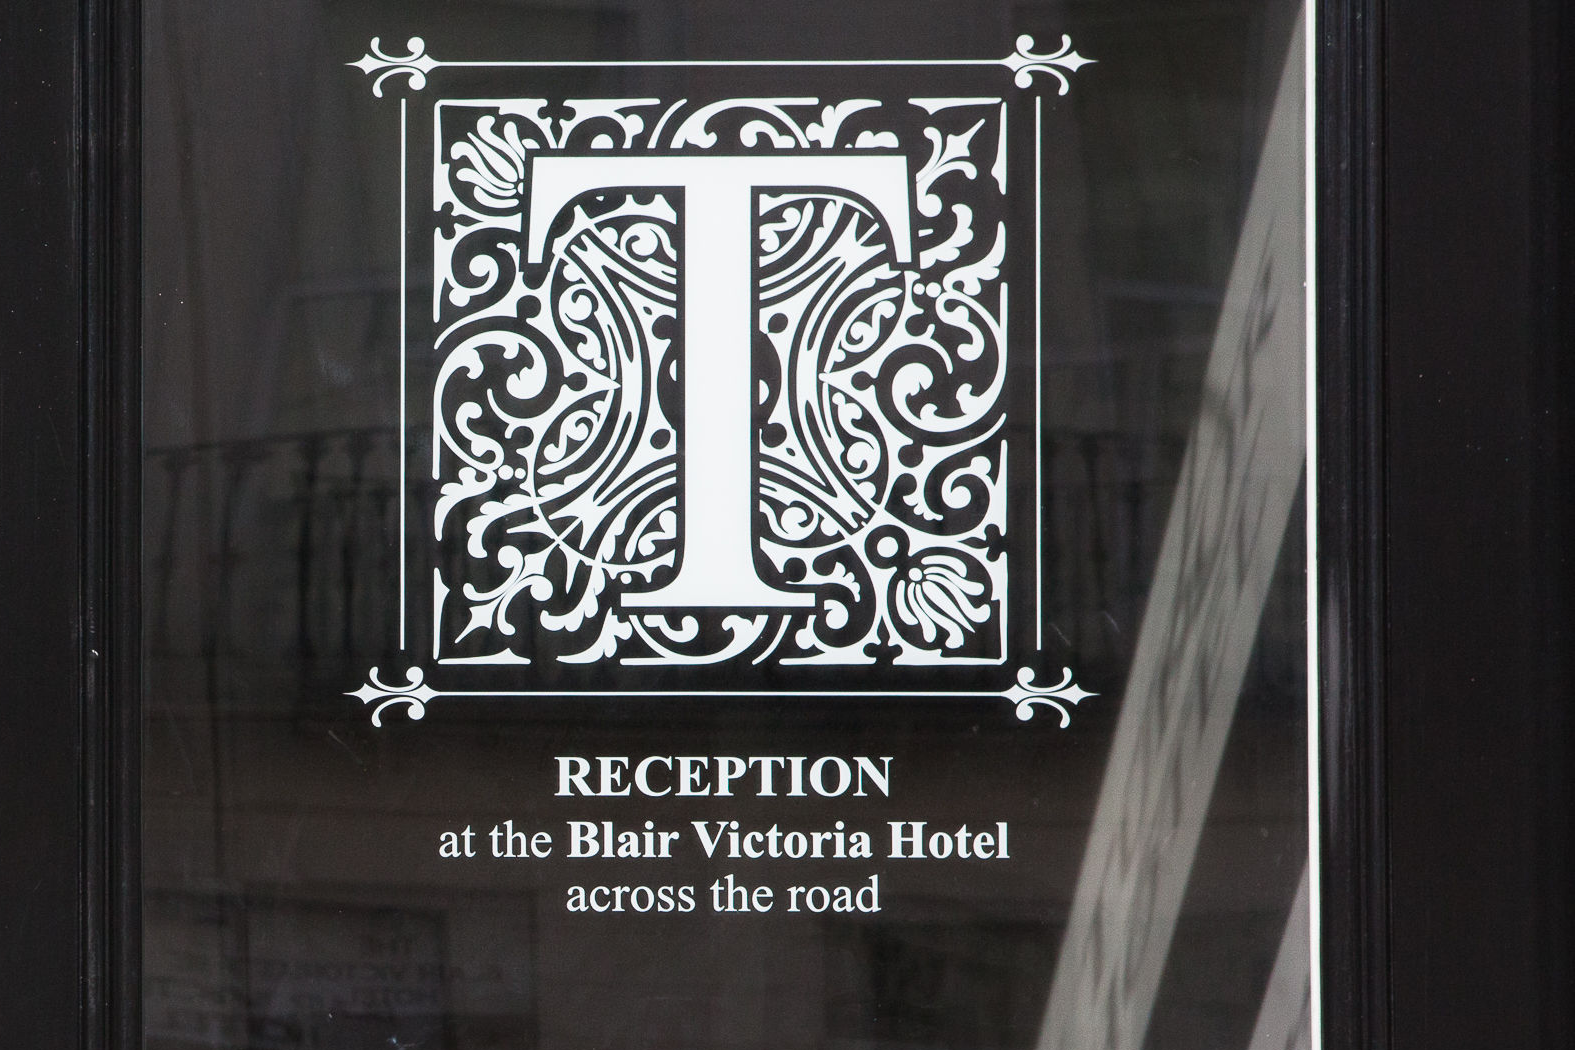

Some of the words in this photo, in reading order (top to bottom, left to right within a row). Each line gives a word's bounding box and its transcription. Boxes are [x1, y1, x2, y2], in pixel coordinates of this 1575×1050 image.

[526, 154, 913, 610] T
[554, 755, 893, 798] RECEPTION
[438, 824, 476, 858] at
[489, 819, 552, 859] the
[566, 820, 680, 858] Blair
[691, 820, 873, 859] Victoria
[887, 821, 1011, 860] Hotel
[566, 885, 696, 913] across
[709, 873, 773, 913] the
[786, 873, 882, 913] road
